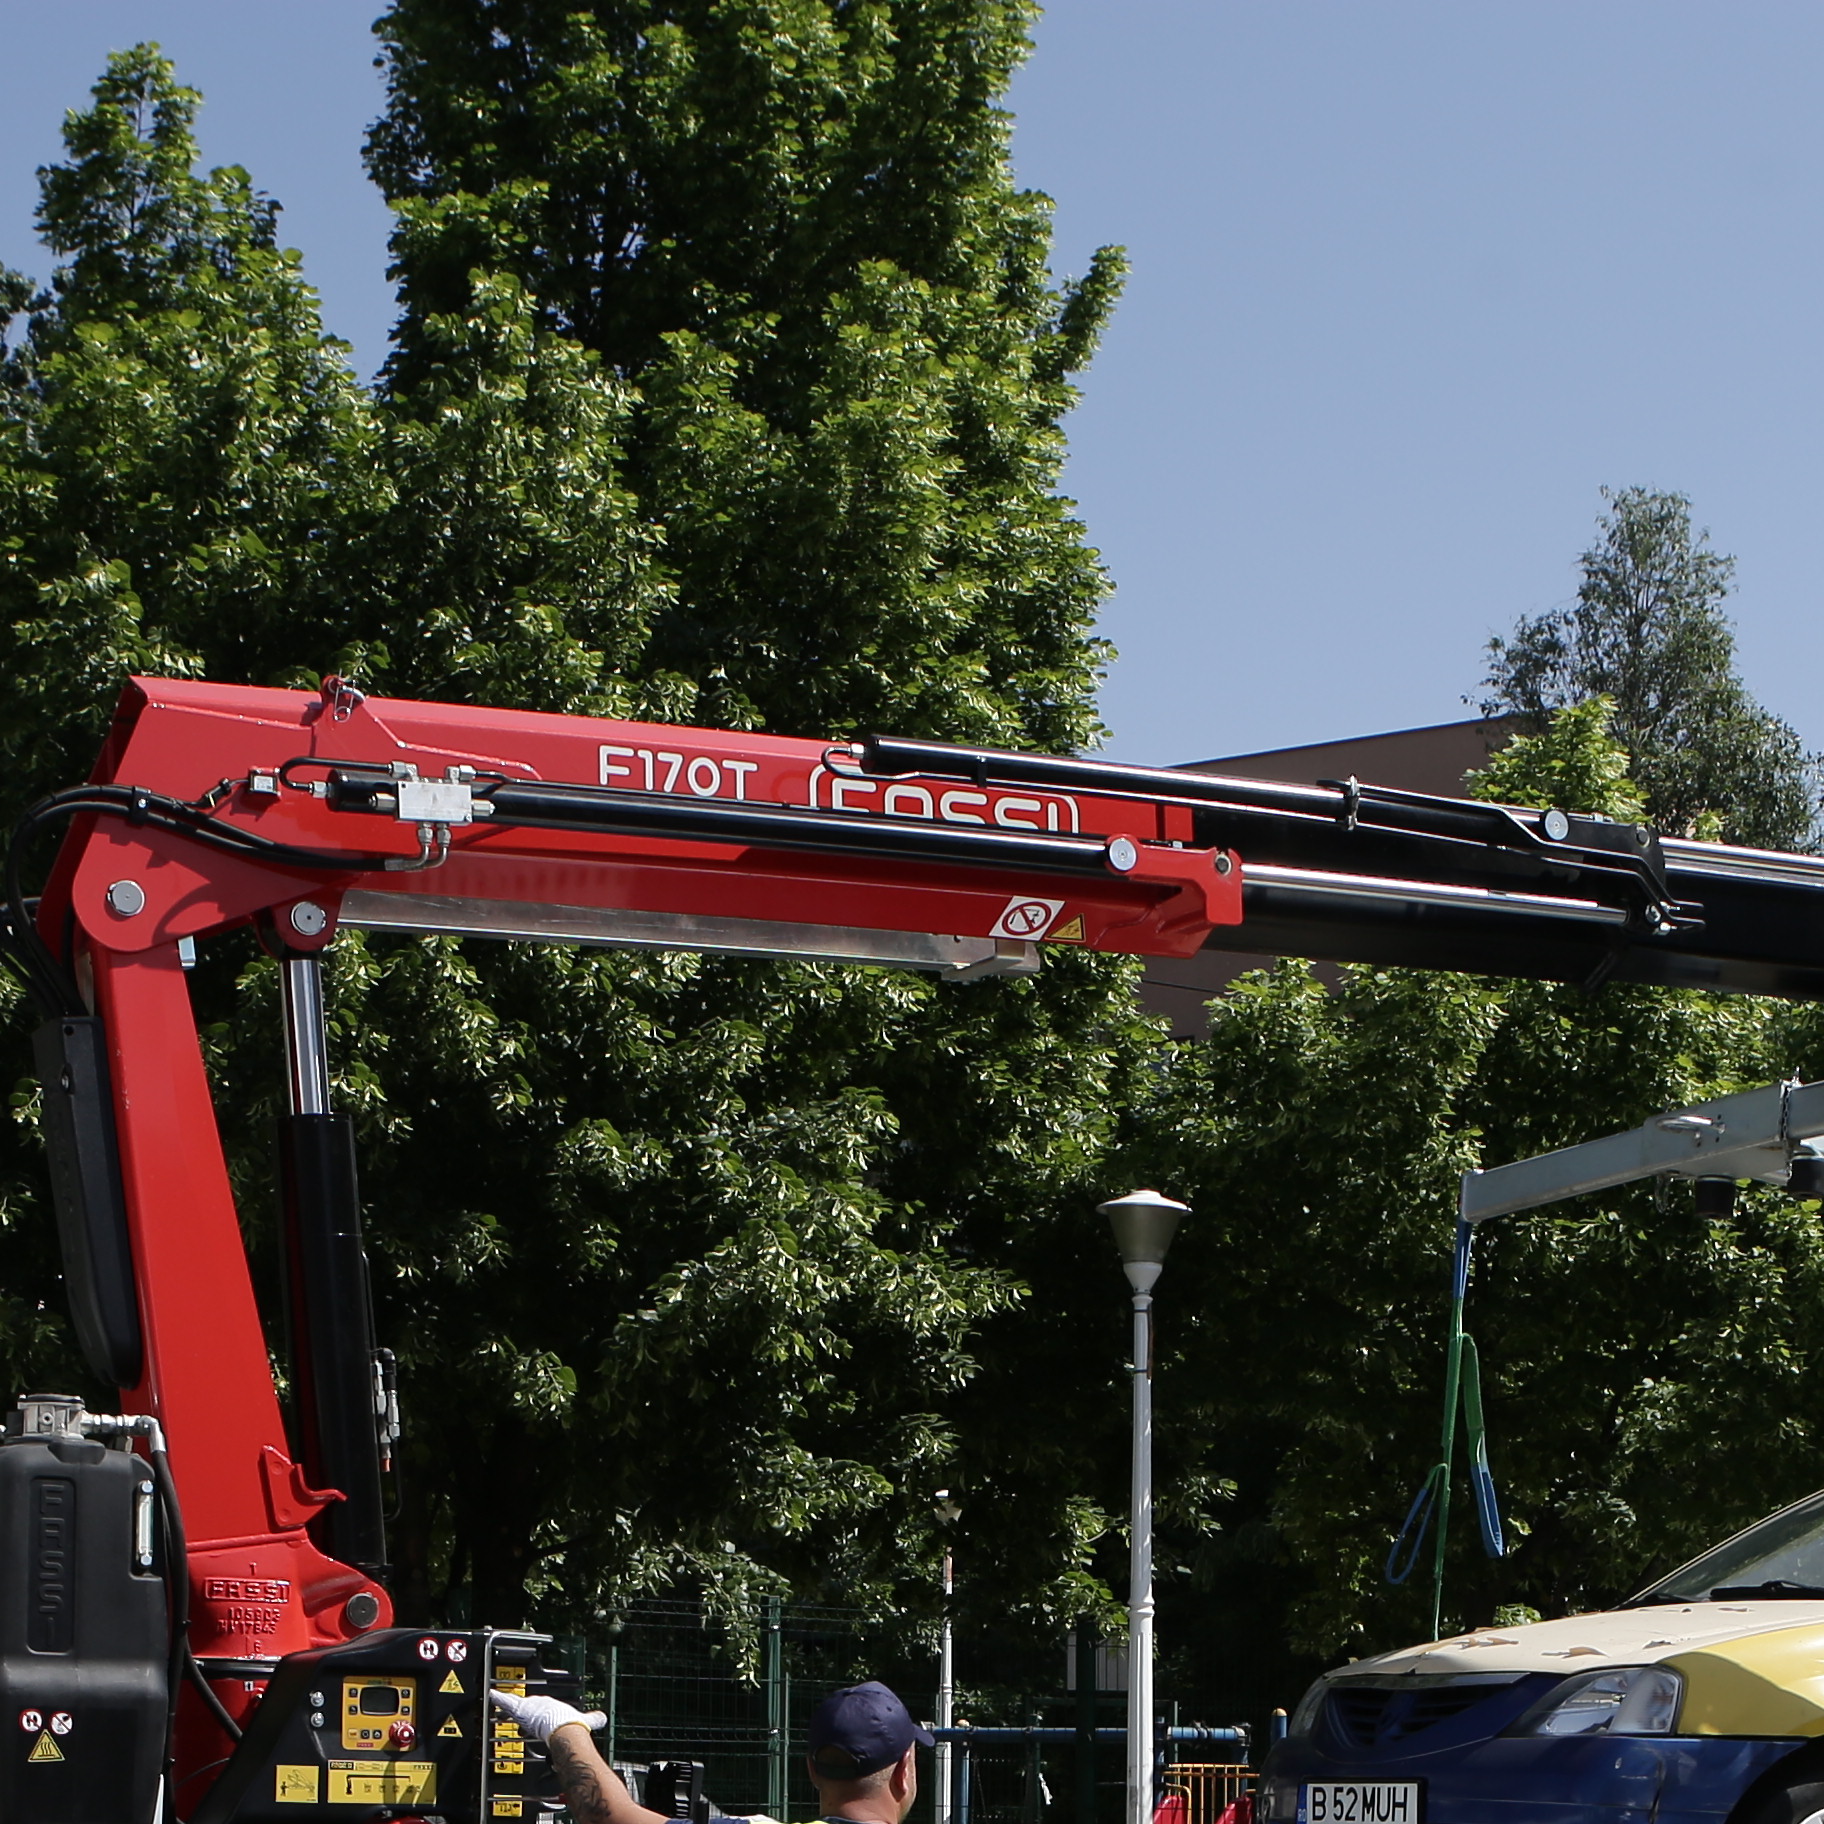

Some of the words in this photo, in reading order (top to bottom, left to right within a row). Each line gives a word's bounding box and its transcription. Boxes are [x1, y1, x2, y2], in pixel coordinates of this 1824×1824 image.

[598, 744, 758, 800] F170T
[1312, 1786, 1326, 1821] B
[1333, 1786, 1358, 1821] 52
[1361, 1786, 1408, 1822] MUH
